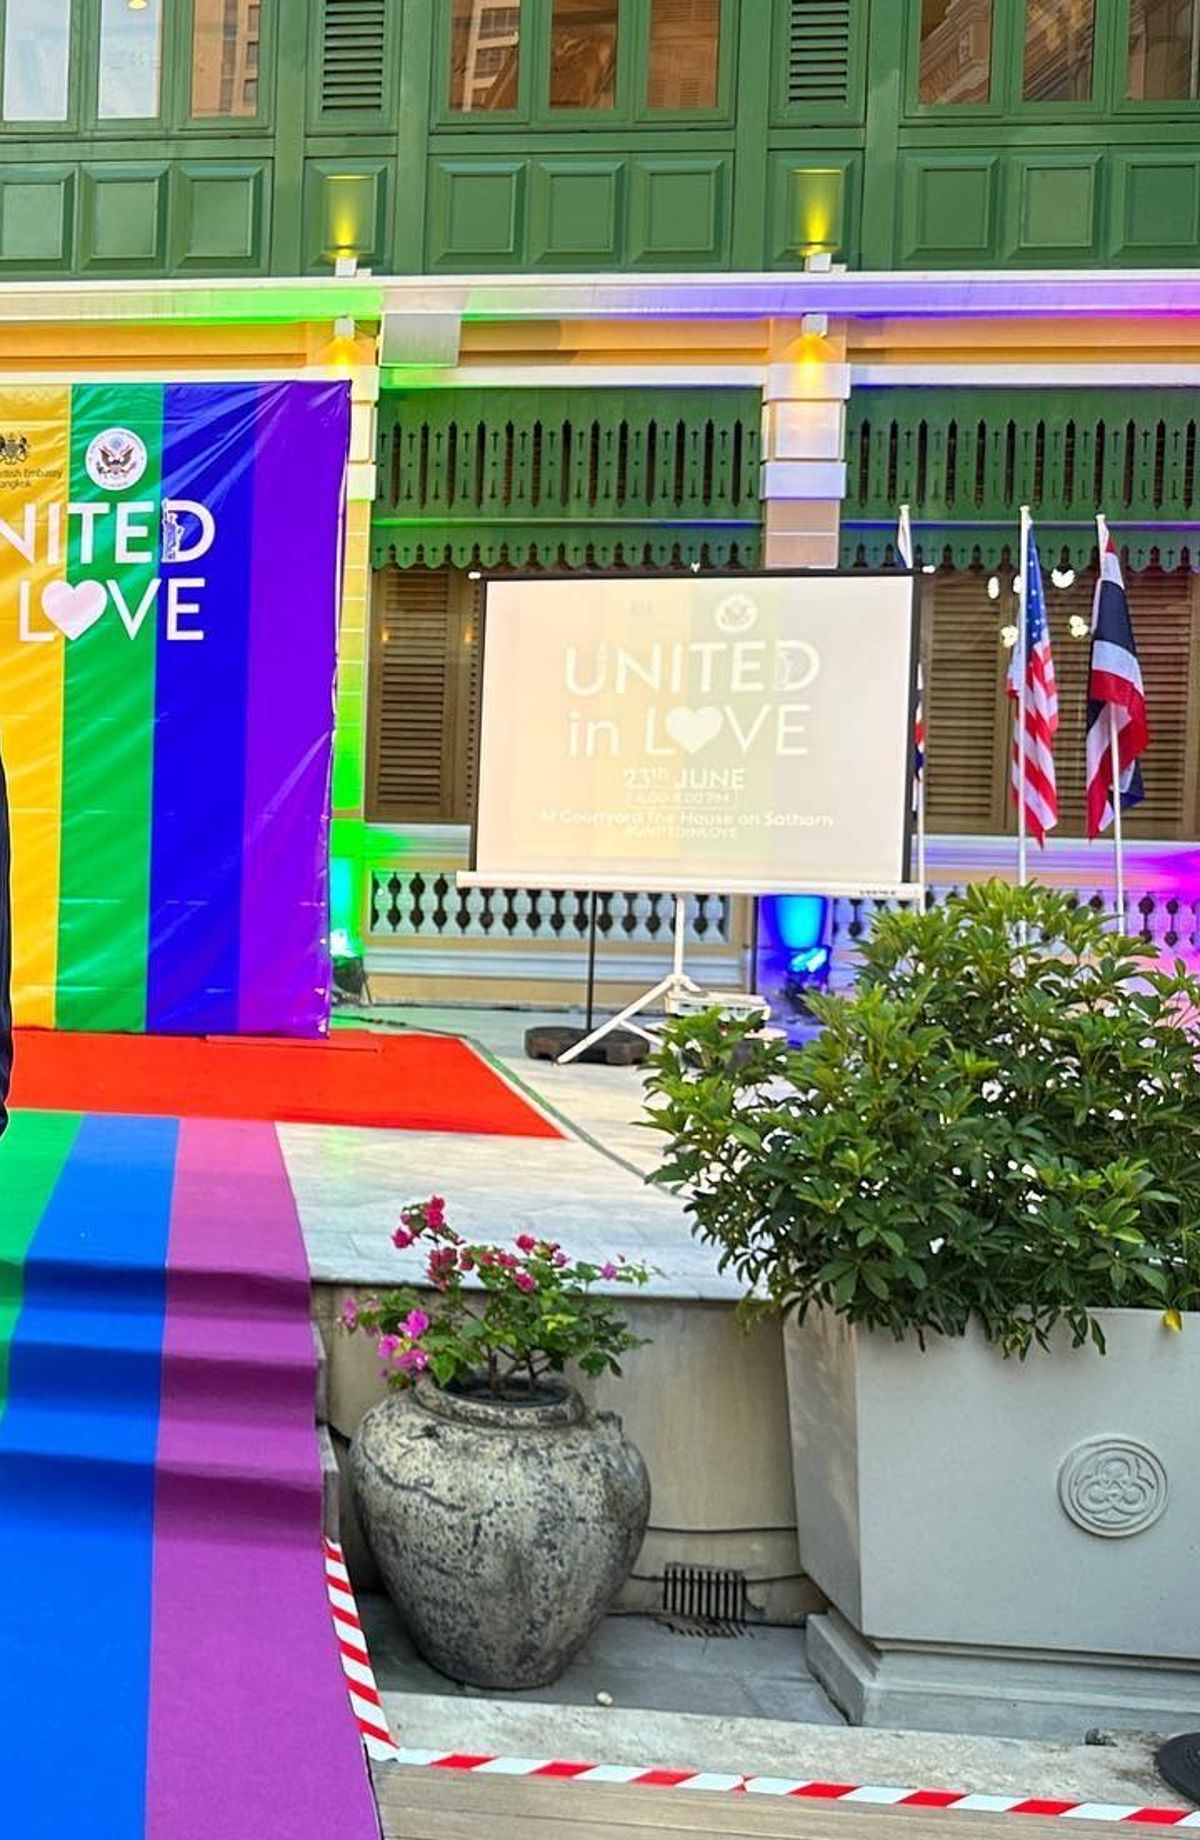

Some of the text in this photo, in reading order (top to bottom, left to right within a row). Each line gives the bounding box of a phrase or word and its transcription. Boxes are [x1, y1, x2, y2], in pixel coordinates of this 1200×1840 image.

[563, 638, 822, 696] UNITED
[567, 711, 620, 757] in
[674, 767, 747, 789] JUNE
[680, 811, 734, 826] House
[737, 813, 761, 826] on
[763, 811, 834, 827] Sathorn
